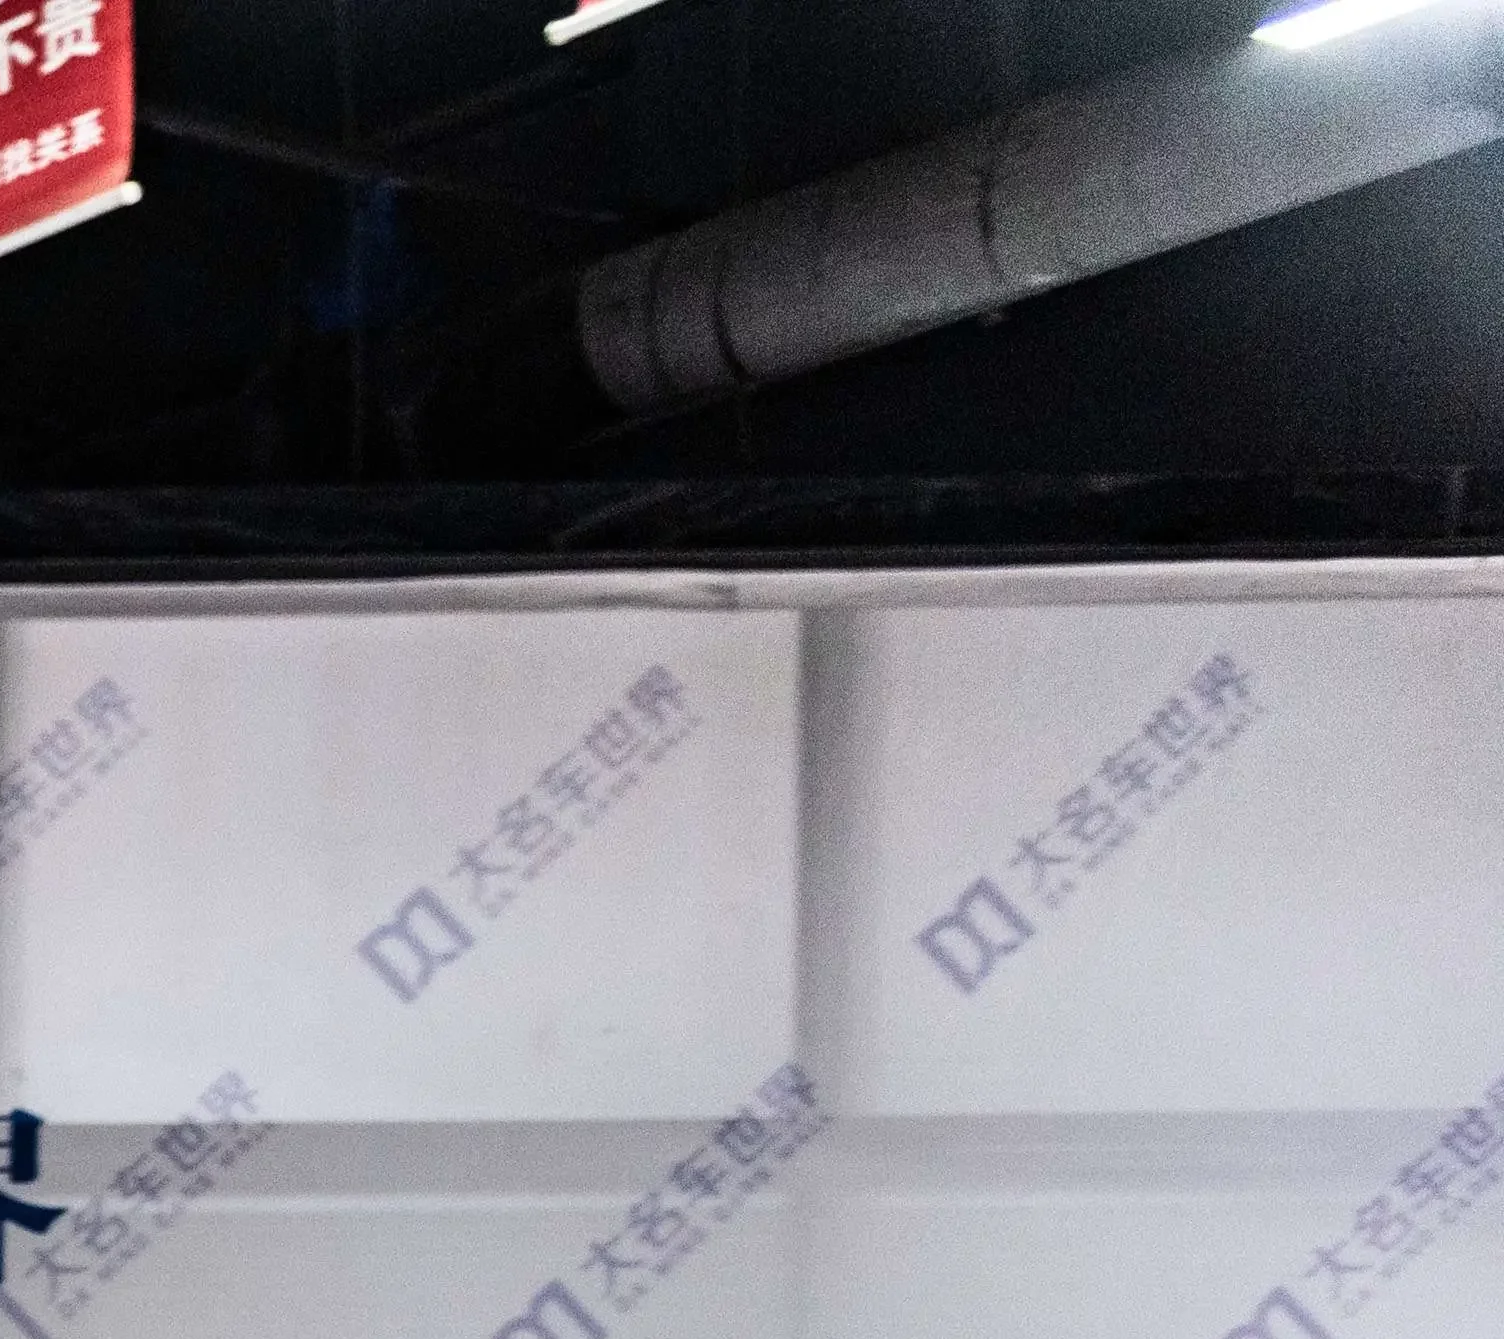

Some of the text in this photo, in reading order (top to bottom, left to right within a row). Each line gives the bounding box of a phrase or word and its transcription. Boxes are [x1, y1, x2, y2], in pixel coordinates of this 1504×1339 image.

[24, 1069, 263, 1301] 大名车世界
[580, 1063, 819, 1295] 大名车世界
[1305, 1074, 1504, 1301] 大名车世
